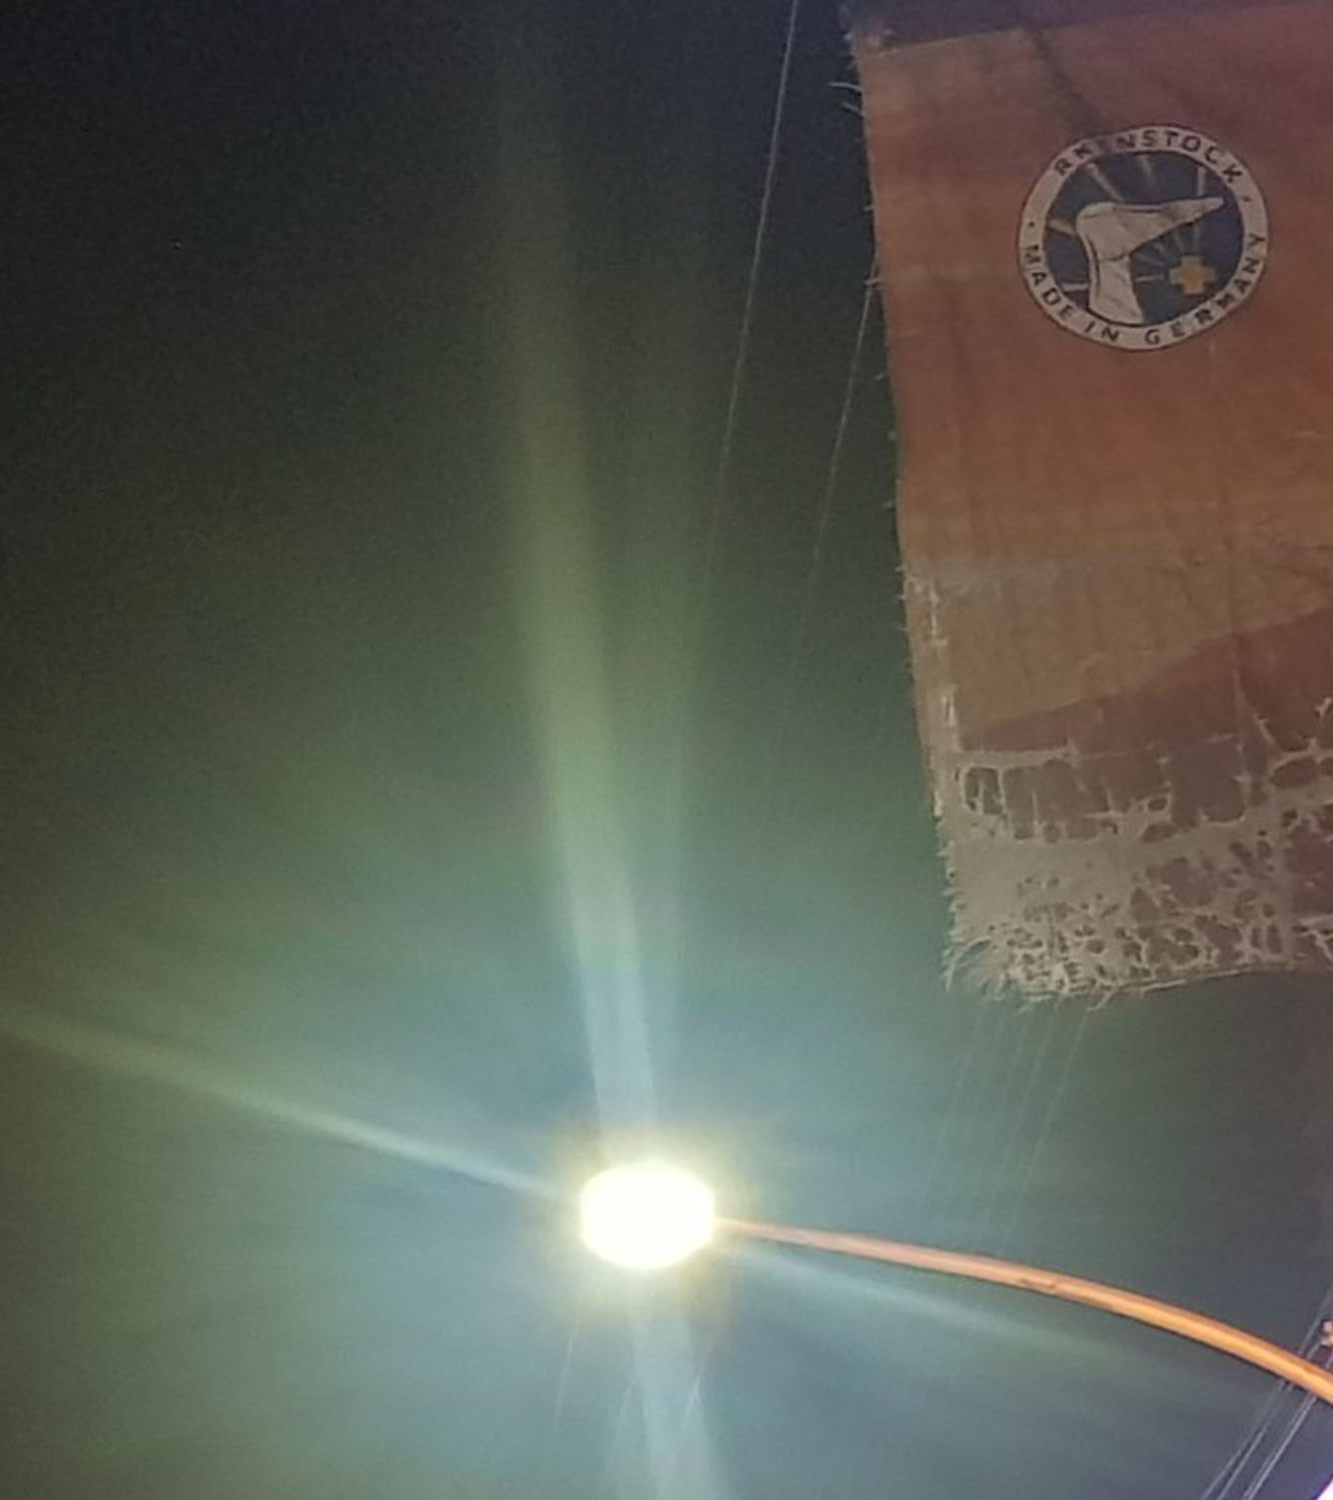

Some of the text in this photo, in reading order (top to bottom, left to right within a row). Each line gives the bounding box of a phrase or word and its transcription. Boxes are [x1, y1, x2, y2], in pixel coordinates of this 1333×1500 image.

[1022, 233, 1268, 346] MADE IN GERMANY
